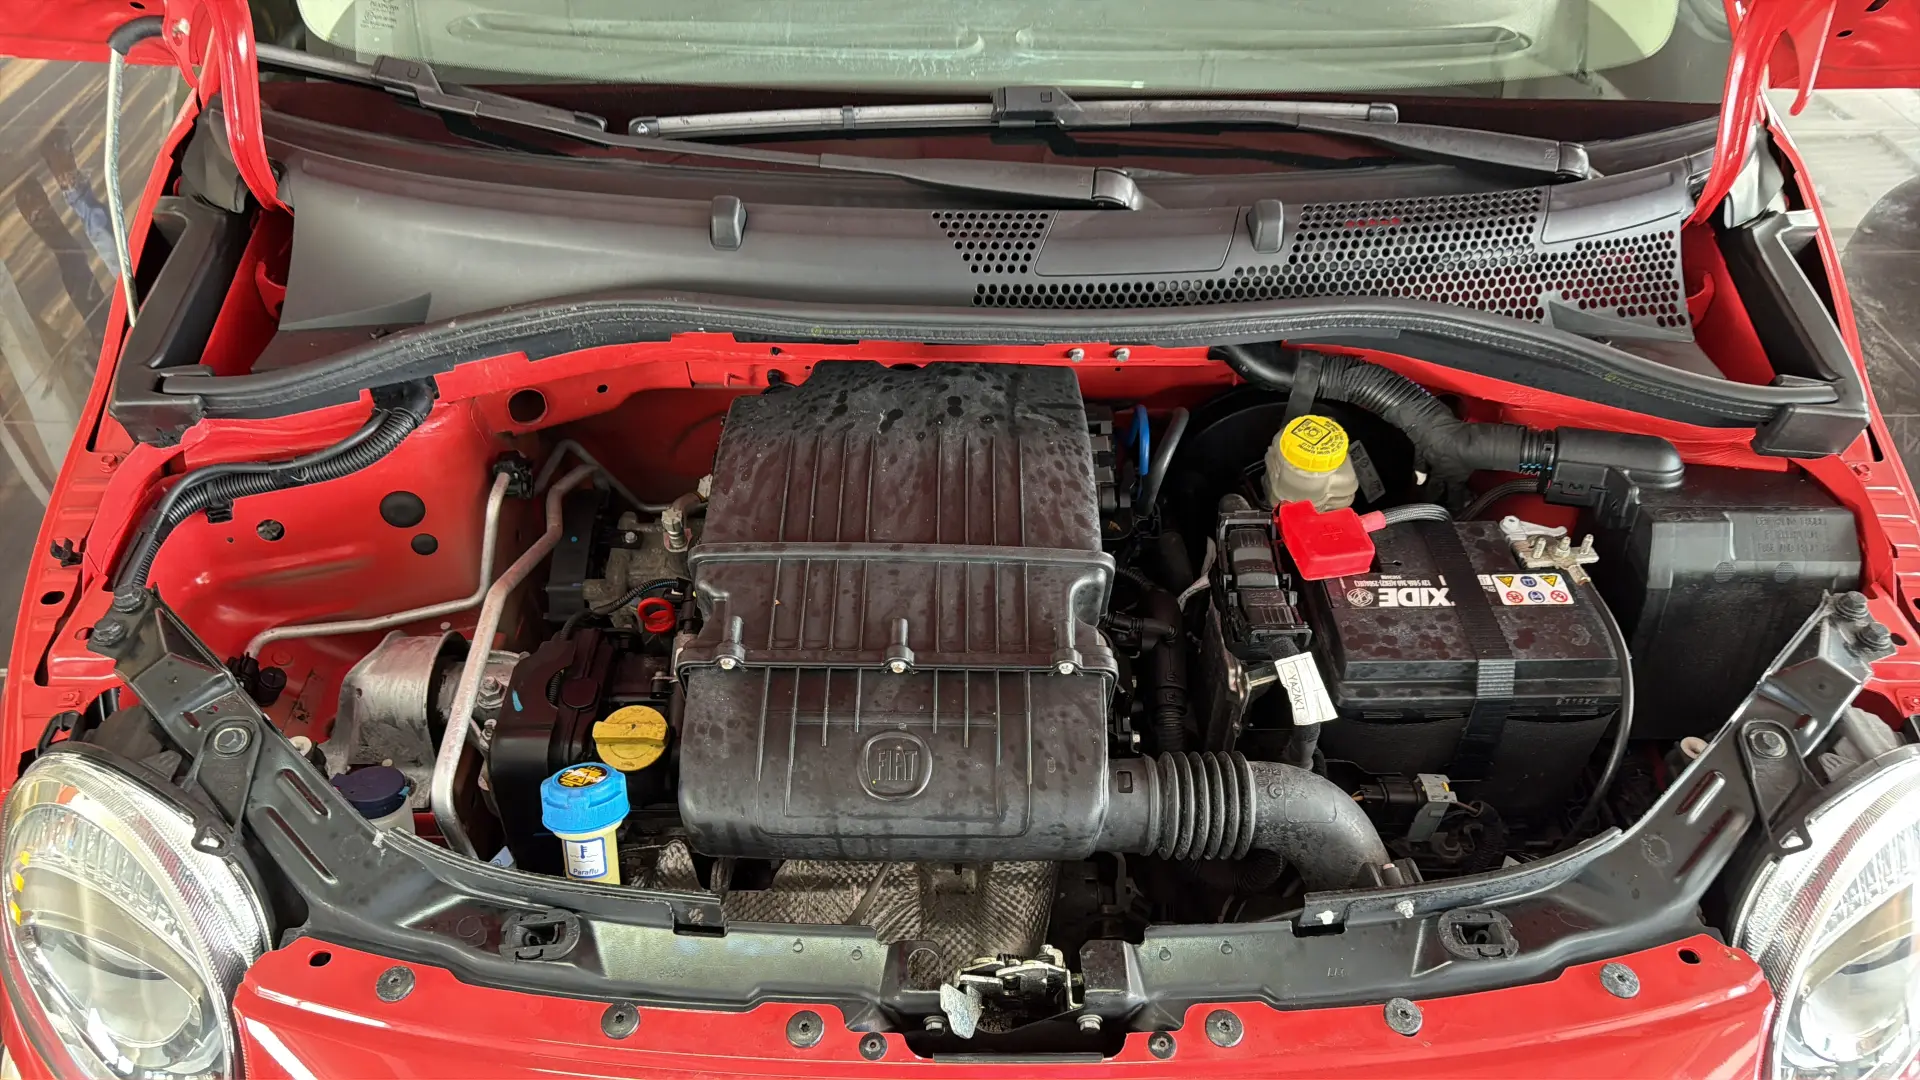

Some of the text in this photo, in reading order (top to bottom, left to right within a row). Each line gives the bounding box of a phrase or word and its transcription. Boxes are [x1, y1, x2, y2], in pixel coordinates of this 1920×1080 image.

[1378, 587, 1456, 607] XIDE
[1288, 674, 1304, 711] YAZAKI
[874, 749, 918, 781] FIAT
[573, 868, 599, 876] Paraflu
